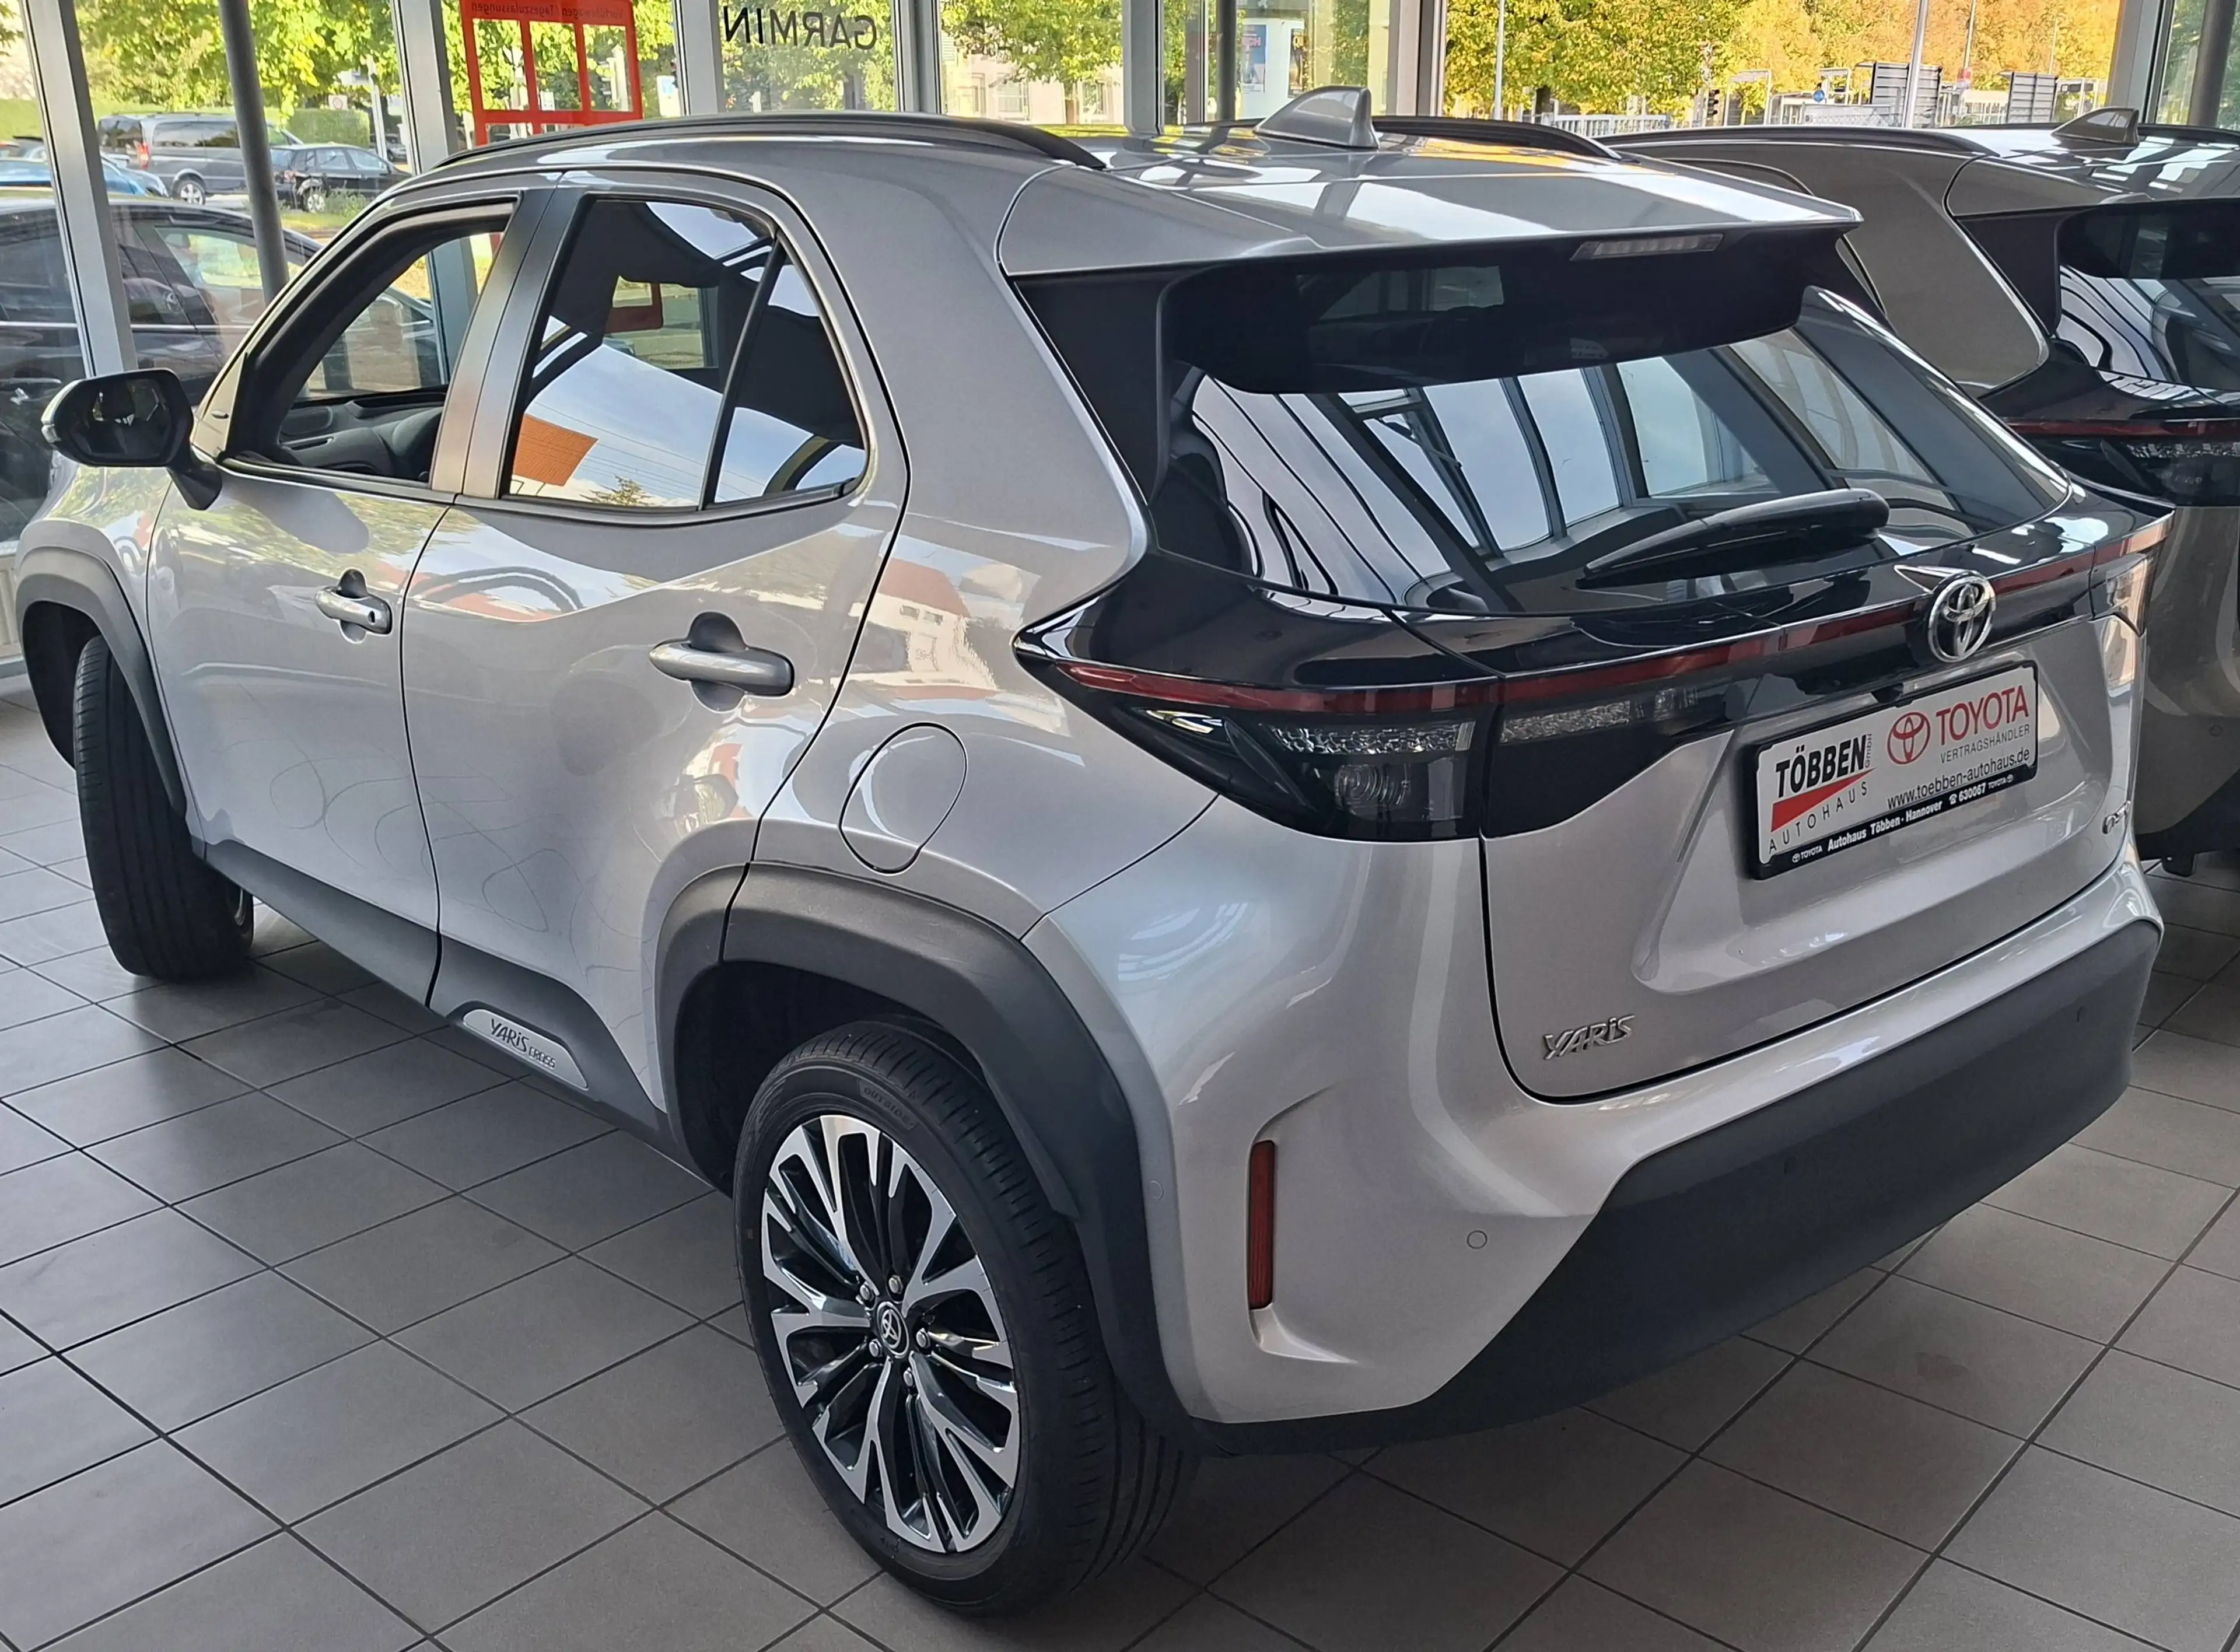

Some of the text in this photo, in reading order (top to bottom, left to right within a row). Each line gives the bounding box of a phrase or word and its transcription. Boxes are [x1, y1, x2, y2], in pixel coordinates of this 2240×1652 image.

[1936, 685, 2029, 746] TOYOTA
[1940, 723, 2031, 764] VERTRAGSHÄNDLER
[1776, 734, 1867, 798] TÖBBEN
[1887, 747, 2030, 810] www.toebben-autohaus.de
[1769, 781, 1867, 855] AUTOHAUS
[1800, 846, 1822, 859] TOYOTA
[1828, 828, 1867, 852] Autohaus
[1870, 816, 1901, 835] Többen
[1906, 801, 1943, 822] Hannover
[1988, 778, 2007, 789] TOYOTA
[528, 1046, 556, 1069] CROSS
